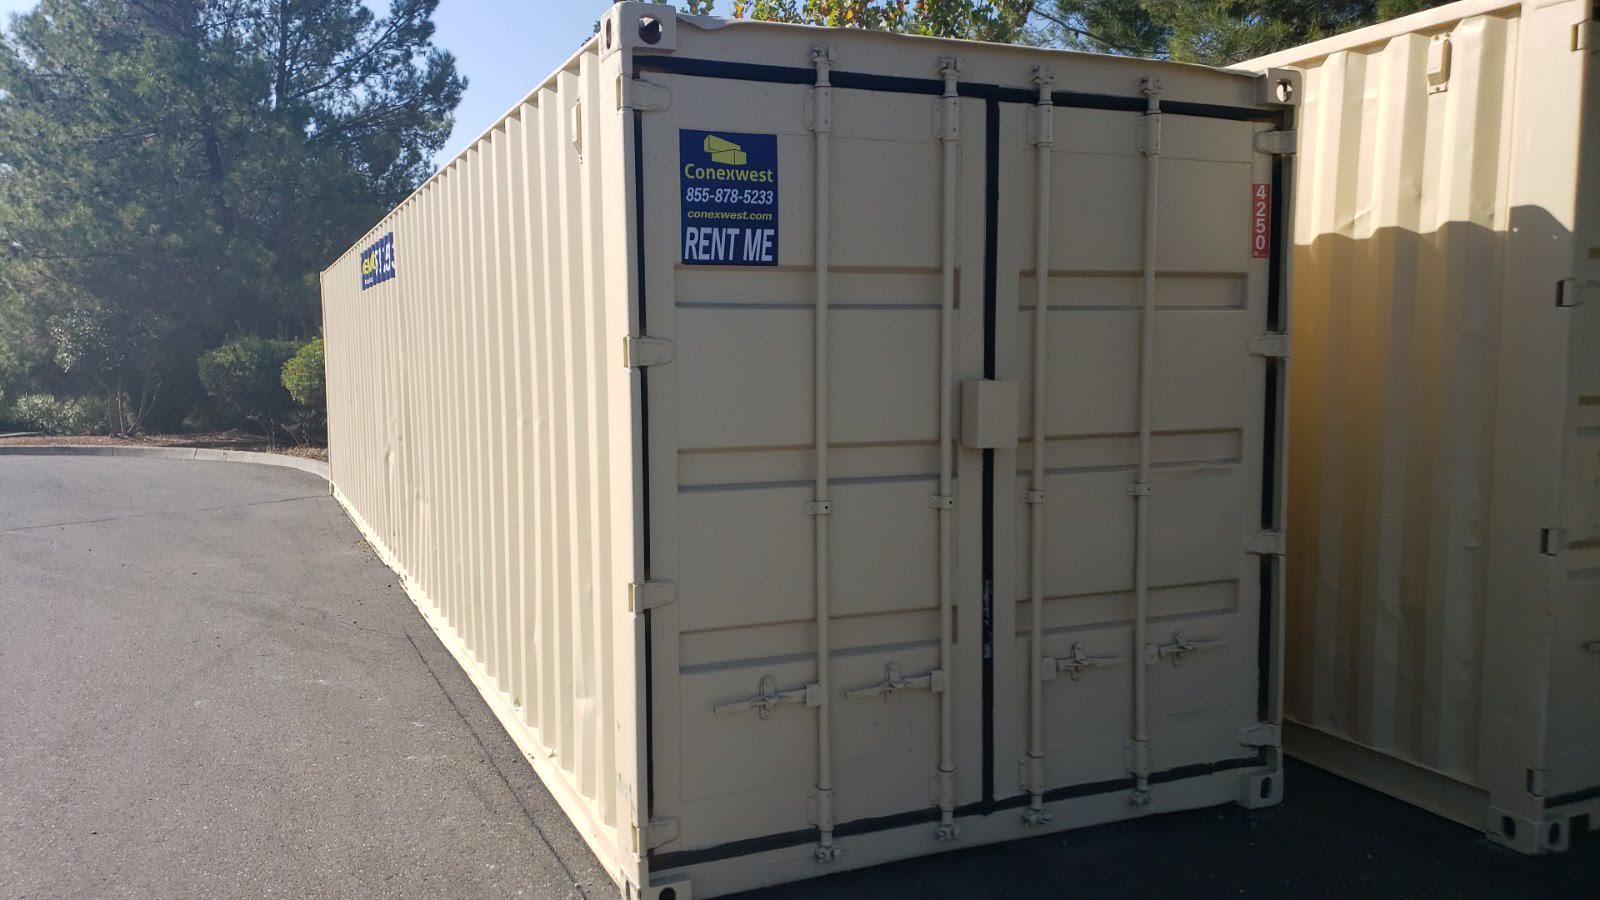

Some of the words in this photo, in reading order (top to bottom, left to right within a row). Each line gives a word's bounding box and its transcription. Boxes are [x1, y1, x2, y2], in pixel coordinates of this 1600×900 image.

[684, 163, 773, 183] Conexwest
[685, 187, 773, 205] 855-878-5233
[687, 209, 772, 220] conexwest.com
[1255, 184, 1266, 250] 4250
[684, 226, 740, 261] RENT
[743, 228, 774, 262] ME
